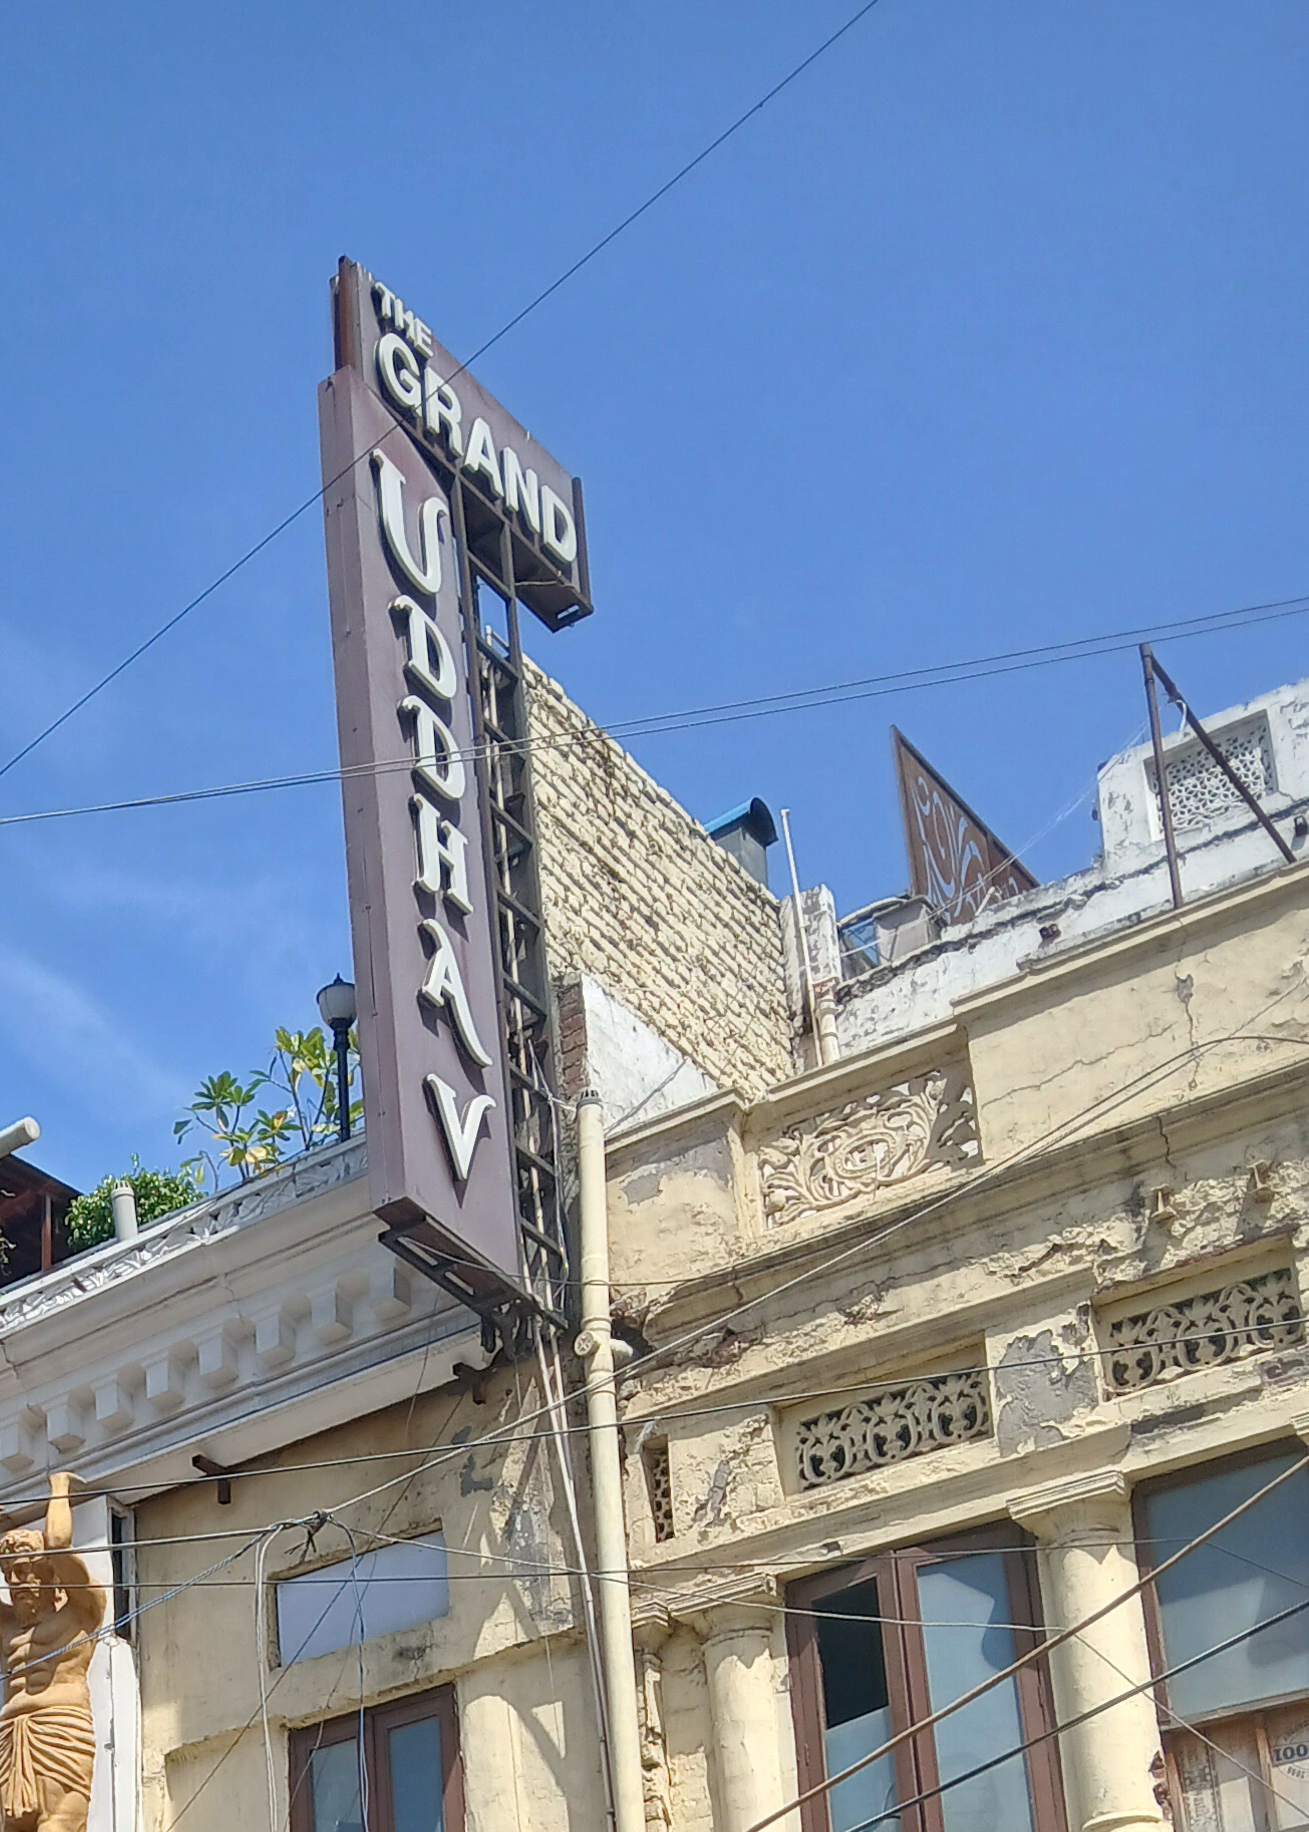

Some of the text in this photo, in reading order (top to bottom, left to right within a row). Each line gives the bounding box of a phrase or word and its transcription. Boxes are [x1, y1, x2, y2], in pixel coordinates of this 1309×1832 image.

[373, 281, 434, 361] THE
[373, 332, 578, 564] GRAND
[370, 446, 496, 1183] UDDHAV
